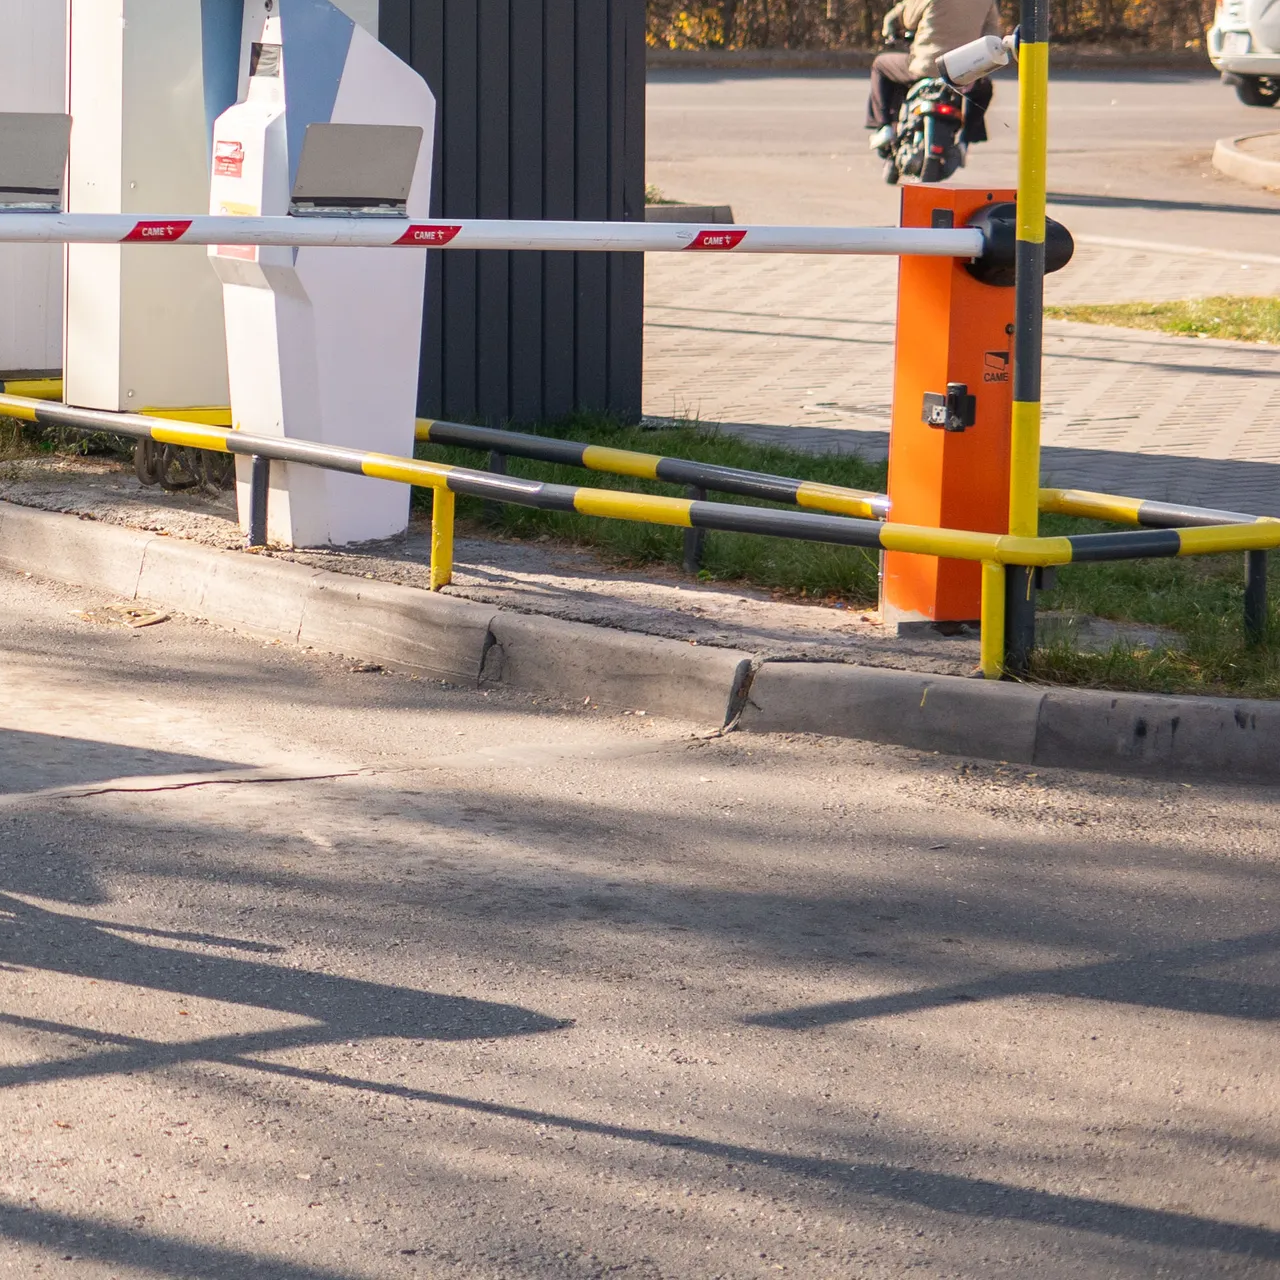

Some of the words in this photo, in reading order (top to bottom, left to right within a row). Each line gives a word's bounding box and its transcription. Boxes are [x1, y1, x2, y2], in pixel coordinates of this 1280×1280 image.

[142, 227, 165, 237] CAME
[414, 231, 436, 240] CAME
[703, 237, 725, 246] CAME
[983, 372, 1009, 382] CAME
